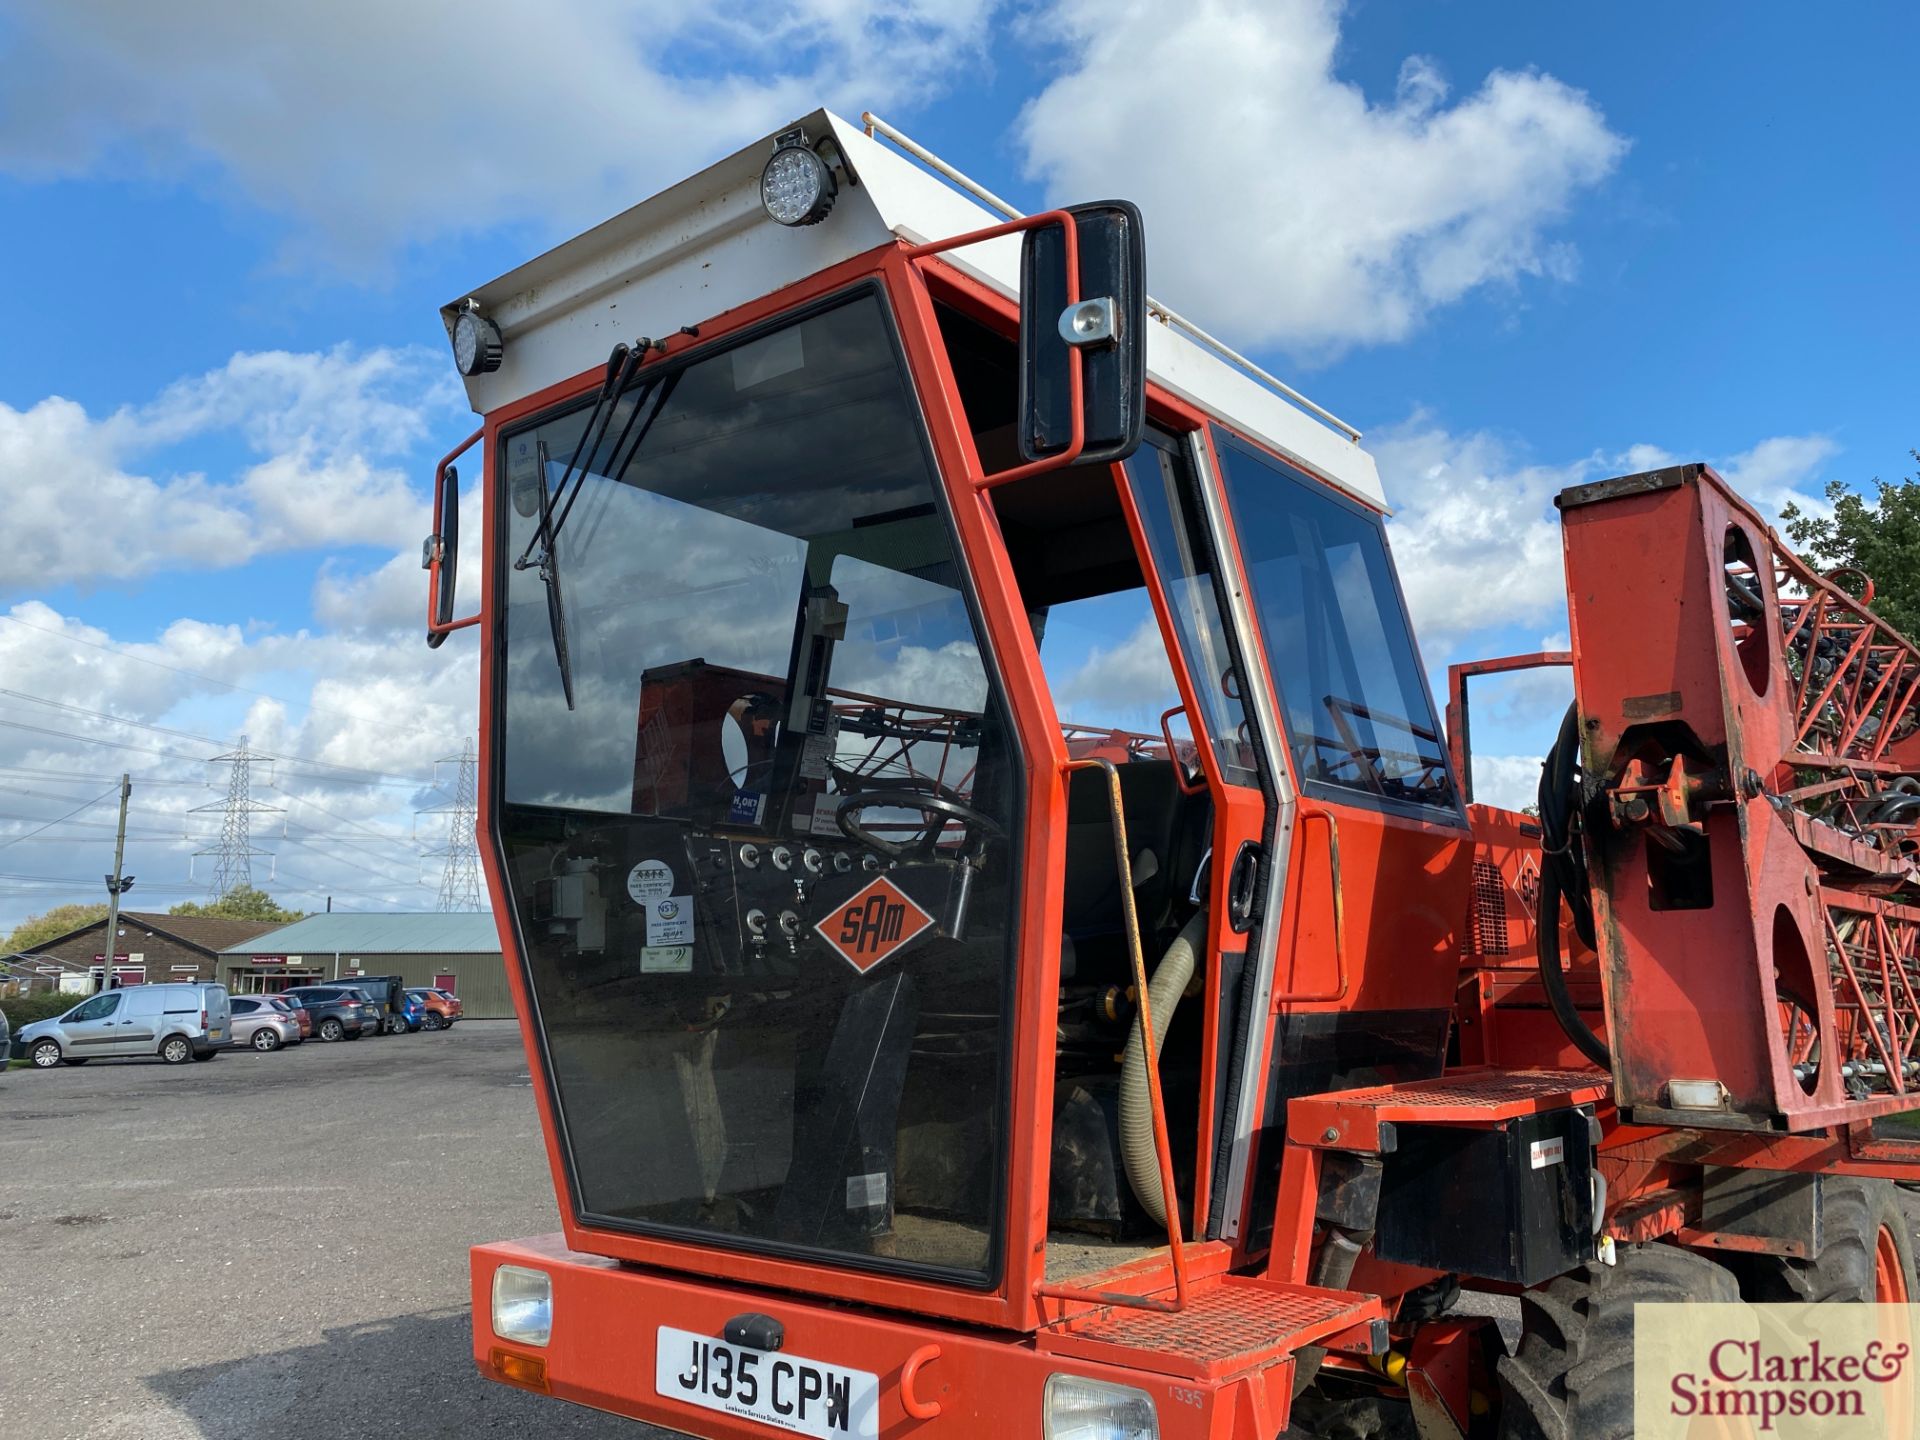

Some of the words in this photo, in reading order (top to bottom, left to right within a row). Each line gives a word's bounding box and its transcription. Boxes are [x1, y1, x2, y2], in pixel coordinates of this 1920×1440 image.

[678, 1340, 759, 1406] J135
[771, 1361, 851, 1432] CPW
[1168, 1386, 1204, 1408] 1335
